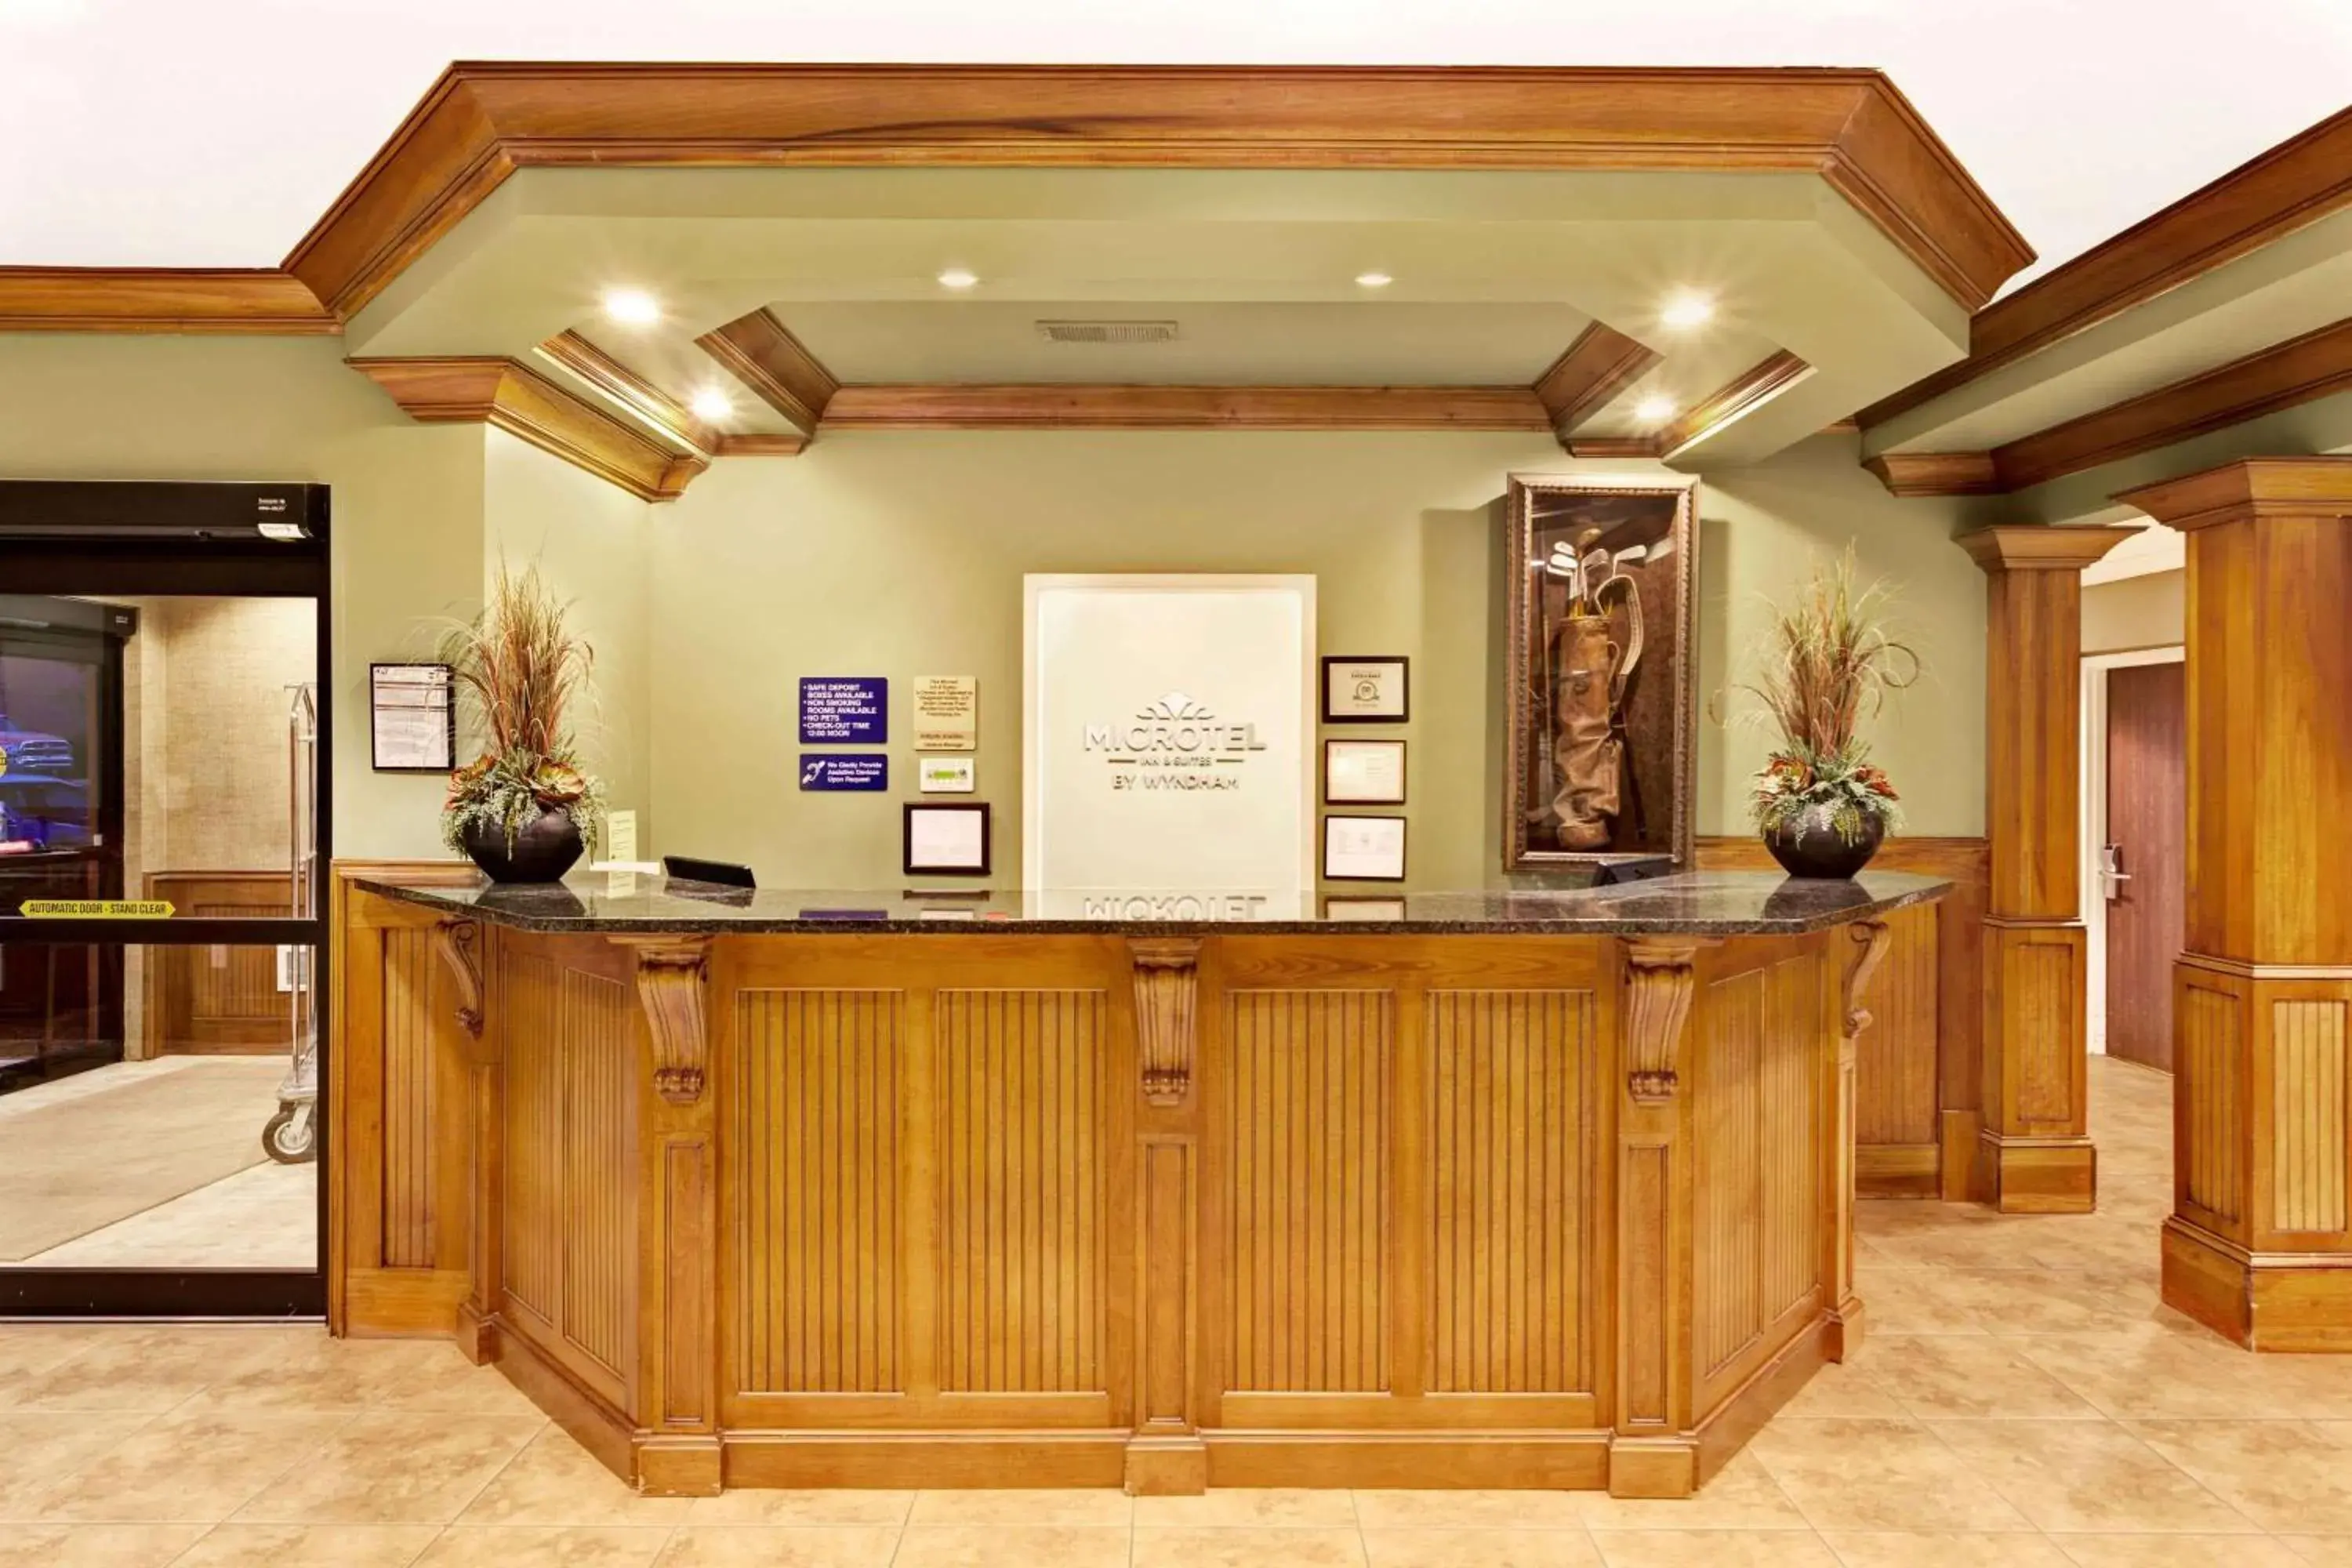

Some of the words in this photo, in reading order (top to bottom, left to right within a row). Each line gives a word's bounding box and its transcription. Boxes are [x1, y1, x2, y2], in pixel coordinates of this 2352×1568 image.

[1082, 723, 1267, 752] MICROTEL
[1173, 757, 1212, 767] SUITES
[1112, 775, 1137, 790] BY
[1142, 775, 1240, 790] WYNDHAM
[29, 902, 78, 913] AUTOMATIC
[79, 902, 103, 913] DOOR
[110, 903, 137, 914] STAND
[139, 903, 166, 914] CLEAR
